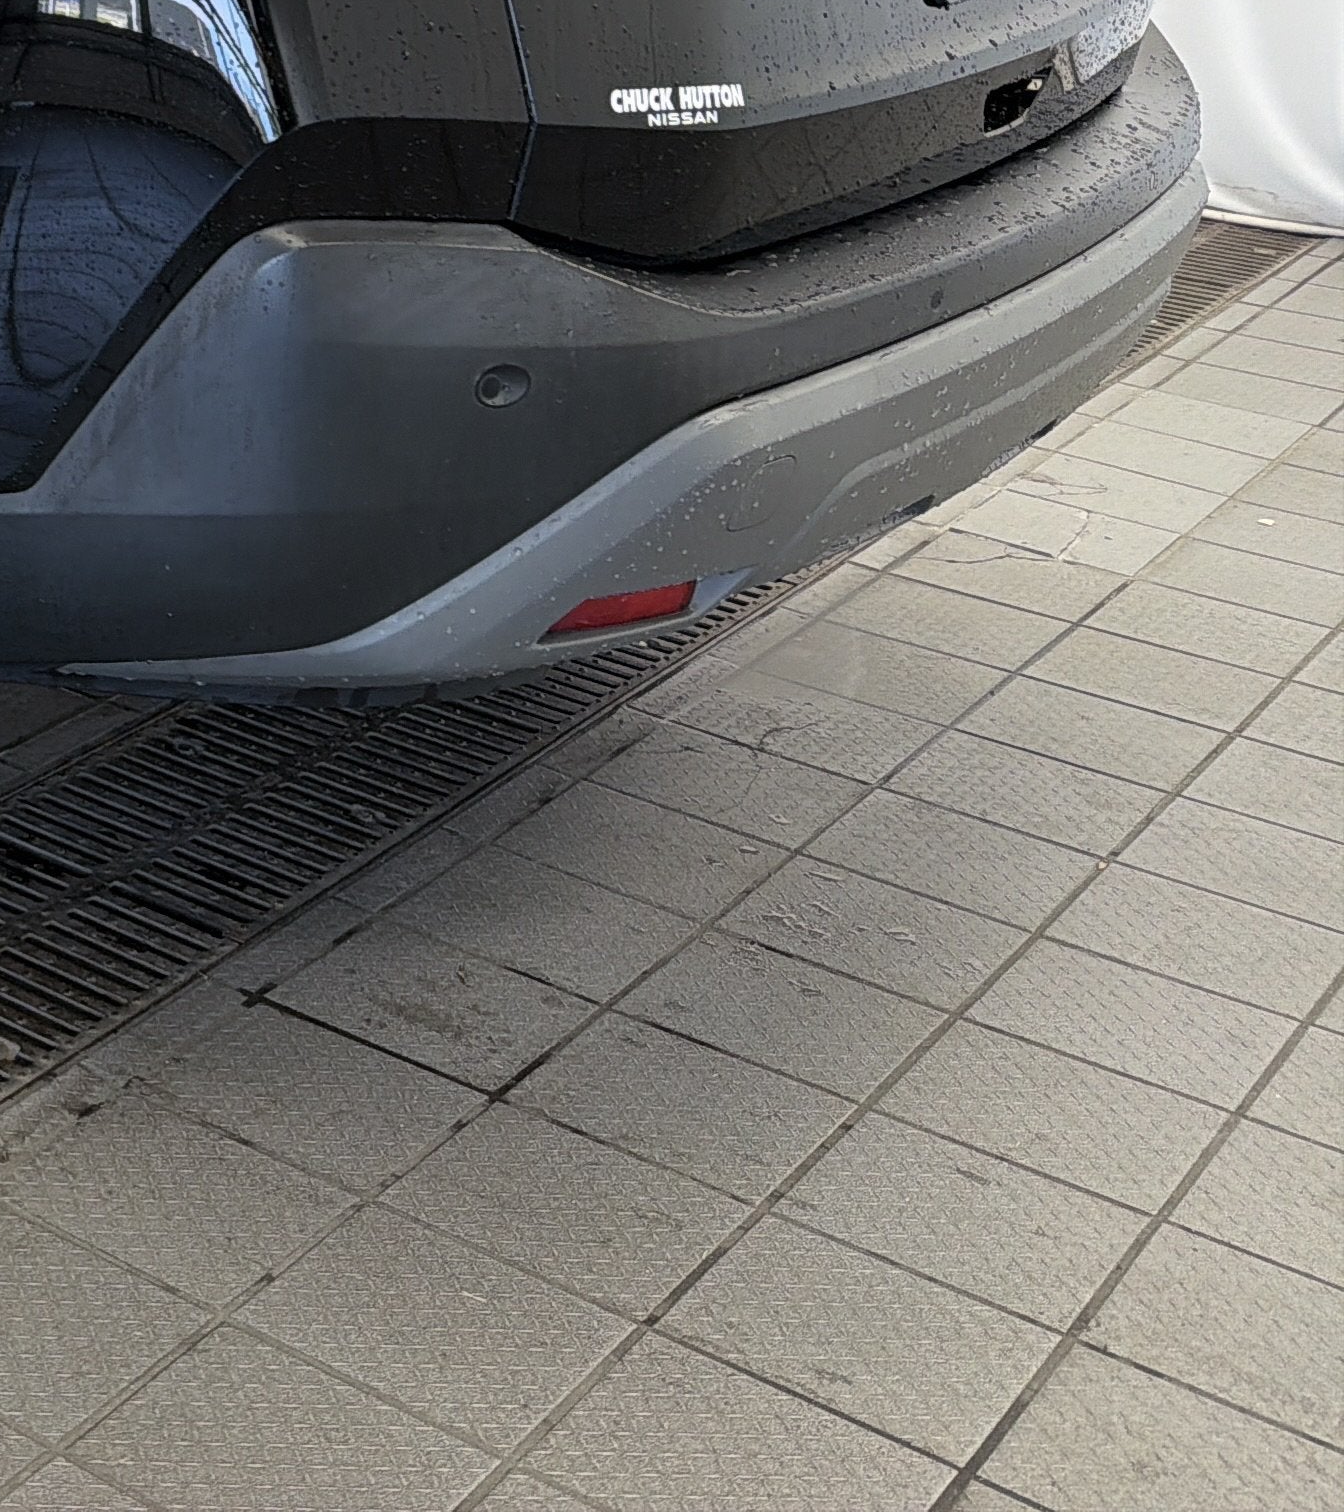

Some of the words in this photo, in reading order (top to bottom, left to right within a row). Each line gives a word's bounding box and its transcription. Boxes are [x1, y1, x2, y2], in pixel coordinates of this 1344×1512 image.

[610, 87, 673, 113] CHUCK
[678, 84, 745, 108] HUTTON
[647, 110, 718, 127] NISSAN
